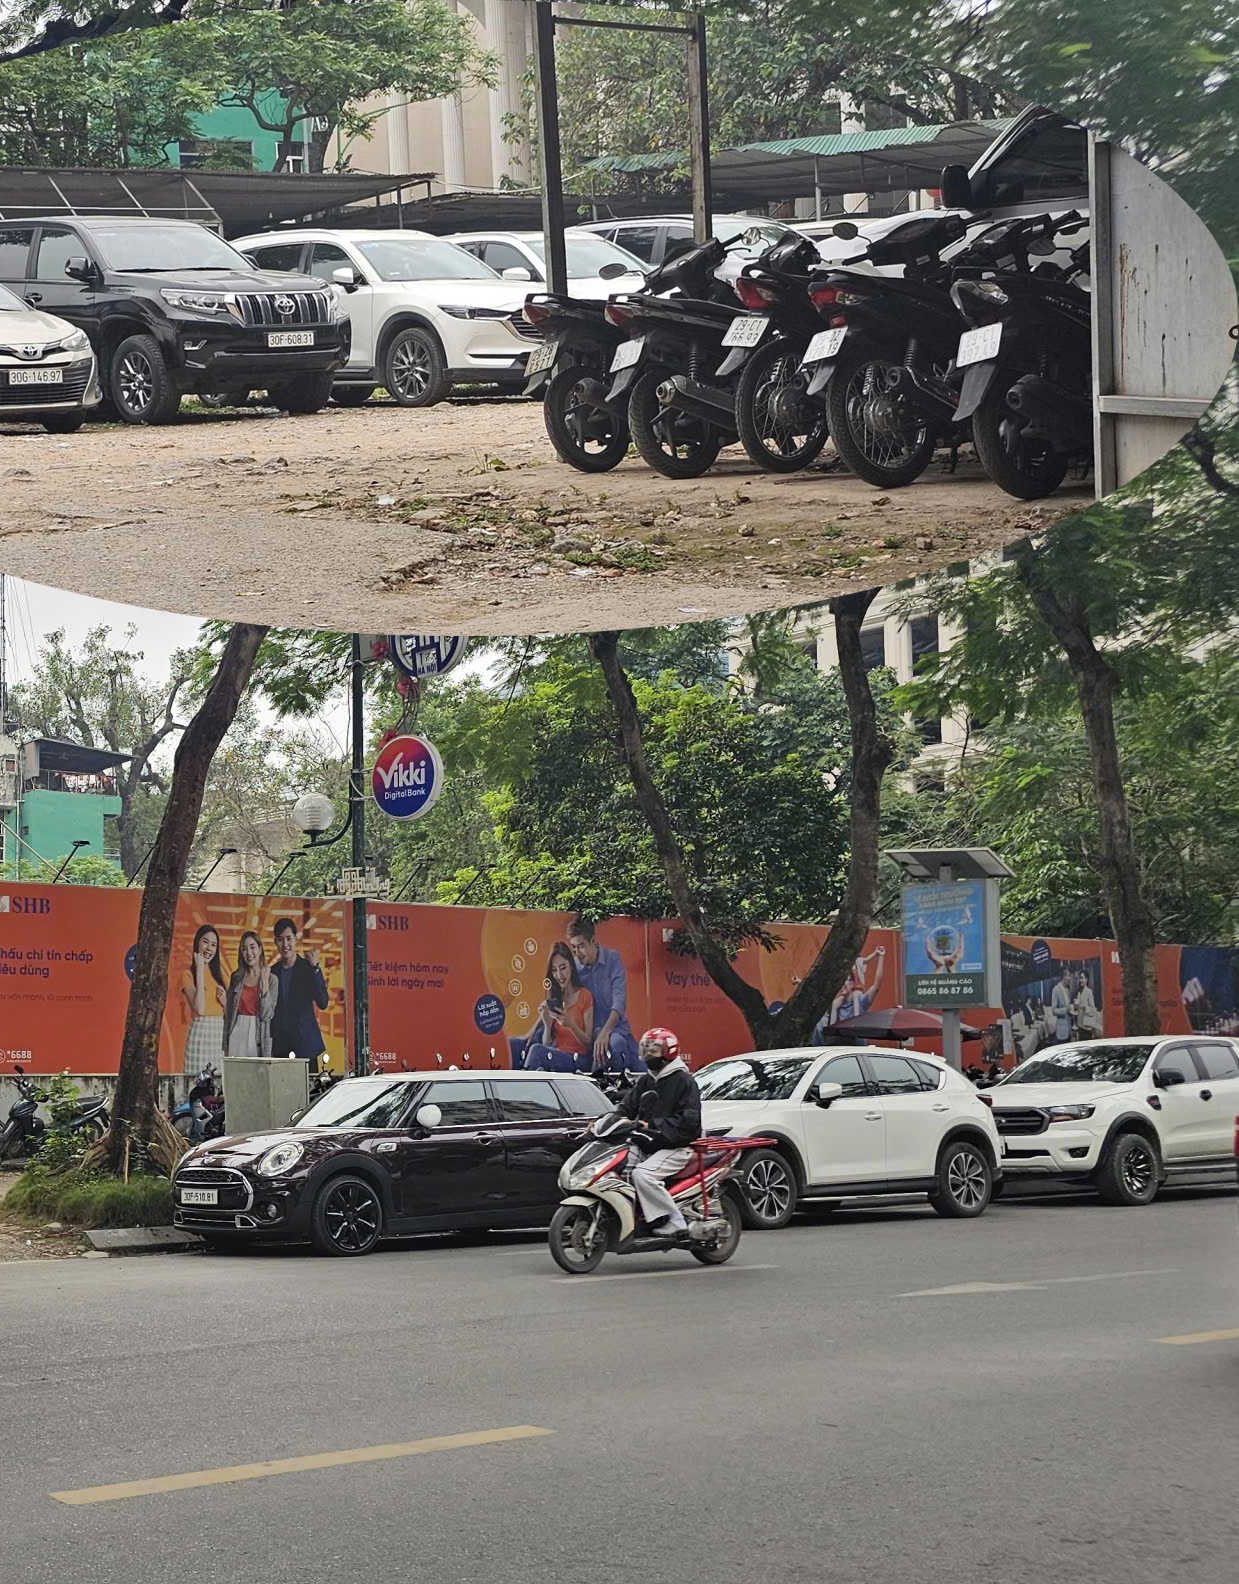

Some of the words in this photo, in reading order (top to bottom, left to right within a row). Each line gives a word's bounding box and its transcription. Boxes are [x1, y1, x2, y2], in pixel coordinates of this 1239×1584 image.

[269, 333, 312, 345] 30F-608.31
[10, 370, 61, 383] 30G-146.97
[376, 752, 426, 789] Vikki
[384, 790, 407, 800] Digital
[407, 788, 426, 796] Bank
[12, 895, 50, 914] SHB
[378, 915, 409, 930] SHB
[26, 949, 43, 960] chi
[64, 948, 93, 964] chấp
[20, 964, 50, 979] dùng
[665, 970, 690, 988] Vay
[917, 987, 937, 995] 0865
[938, 987, 950, 995] 86
[950, 986, 961, 994] 87
[962, 986, 974, 994] 86
